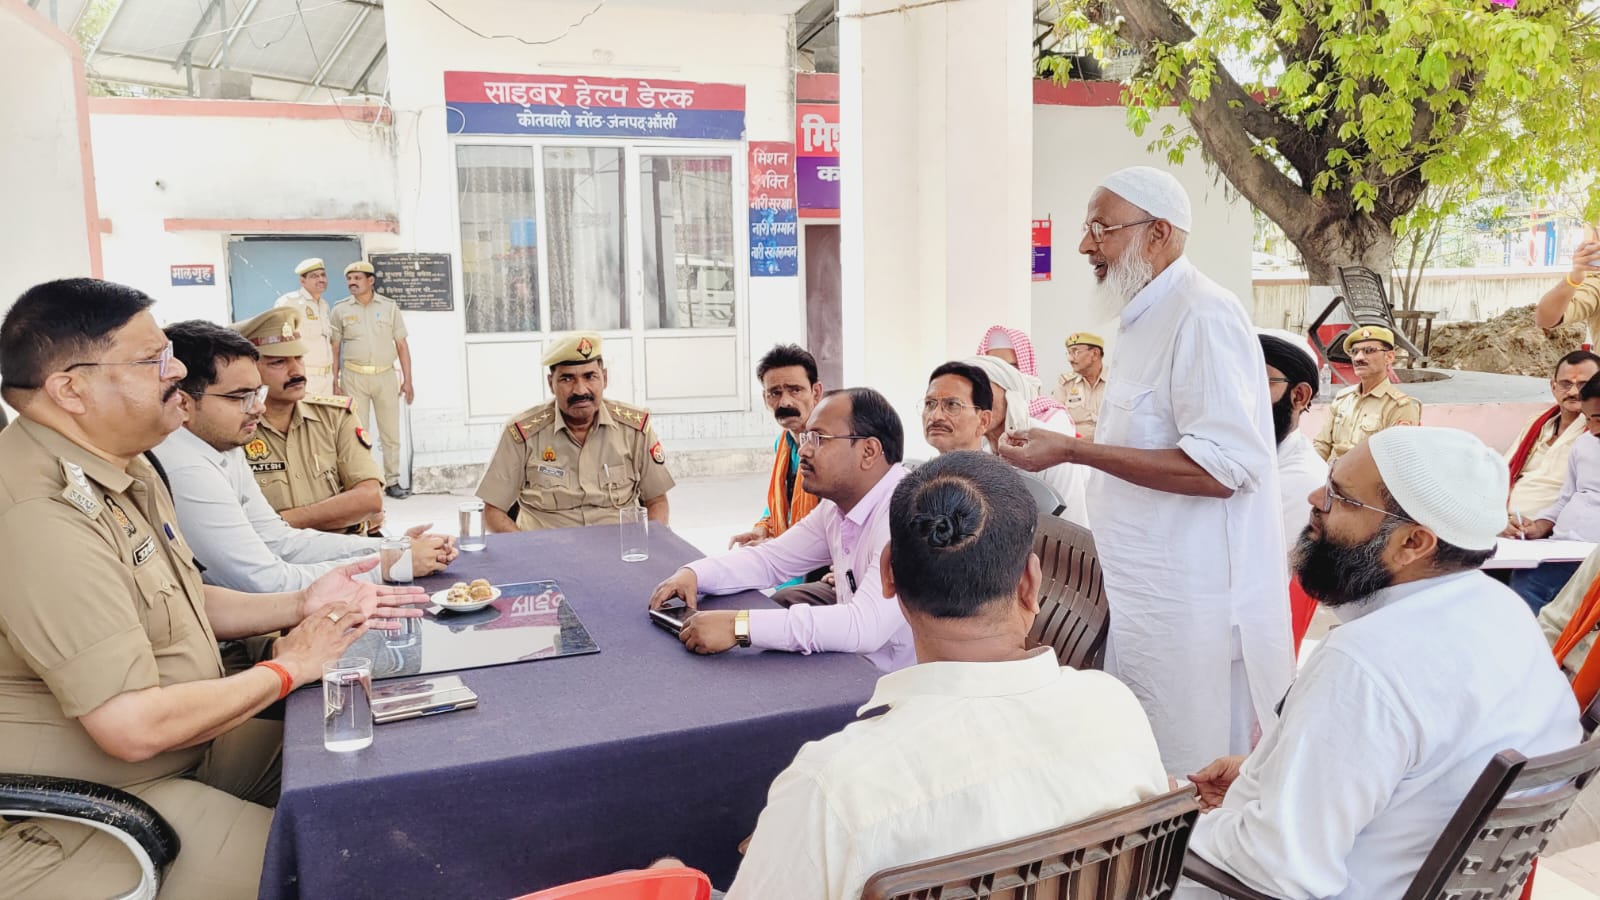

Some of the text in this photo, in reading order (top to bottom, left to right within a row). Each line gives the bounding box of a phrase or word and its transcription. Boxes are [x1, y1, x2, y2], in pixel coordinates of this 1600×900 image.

[484, 79, 694, 109] साइबर हेल्प डेस्क
[516, 109, 572, 128] कोतवाली
[753, 148, 788, 166] मिशन
[768, 198, 792, 214] सुरक्षा
[752, 219, 769, 236] नारी
[751, 242, 764, 259] नारी
[172, 267, 211, 283] मालगृह
[251, 463, 282, 471] AJESH
